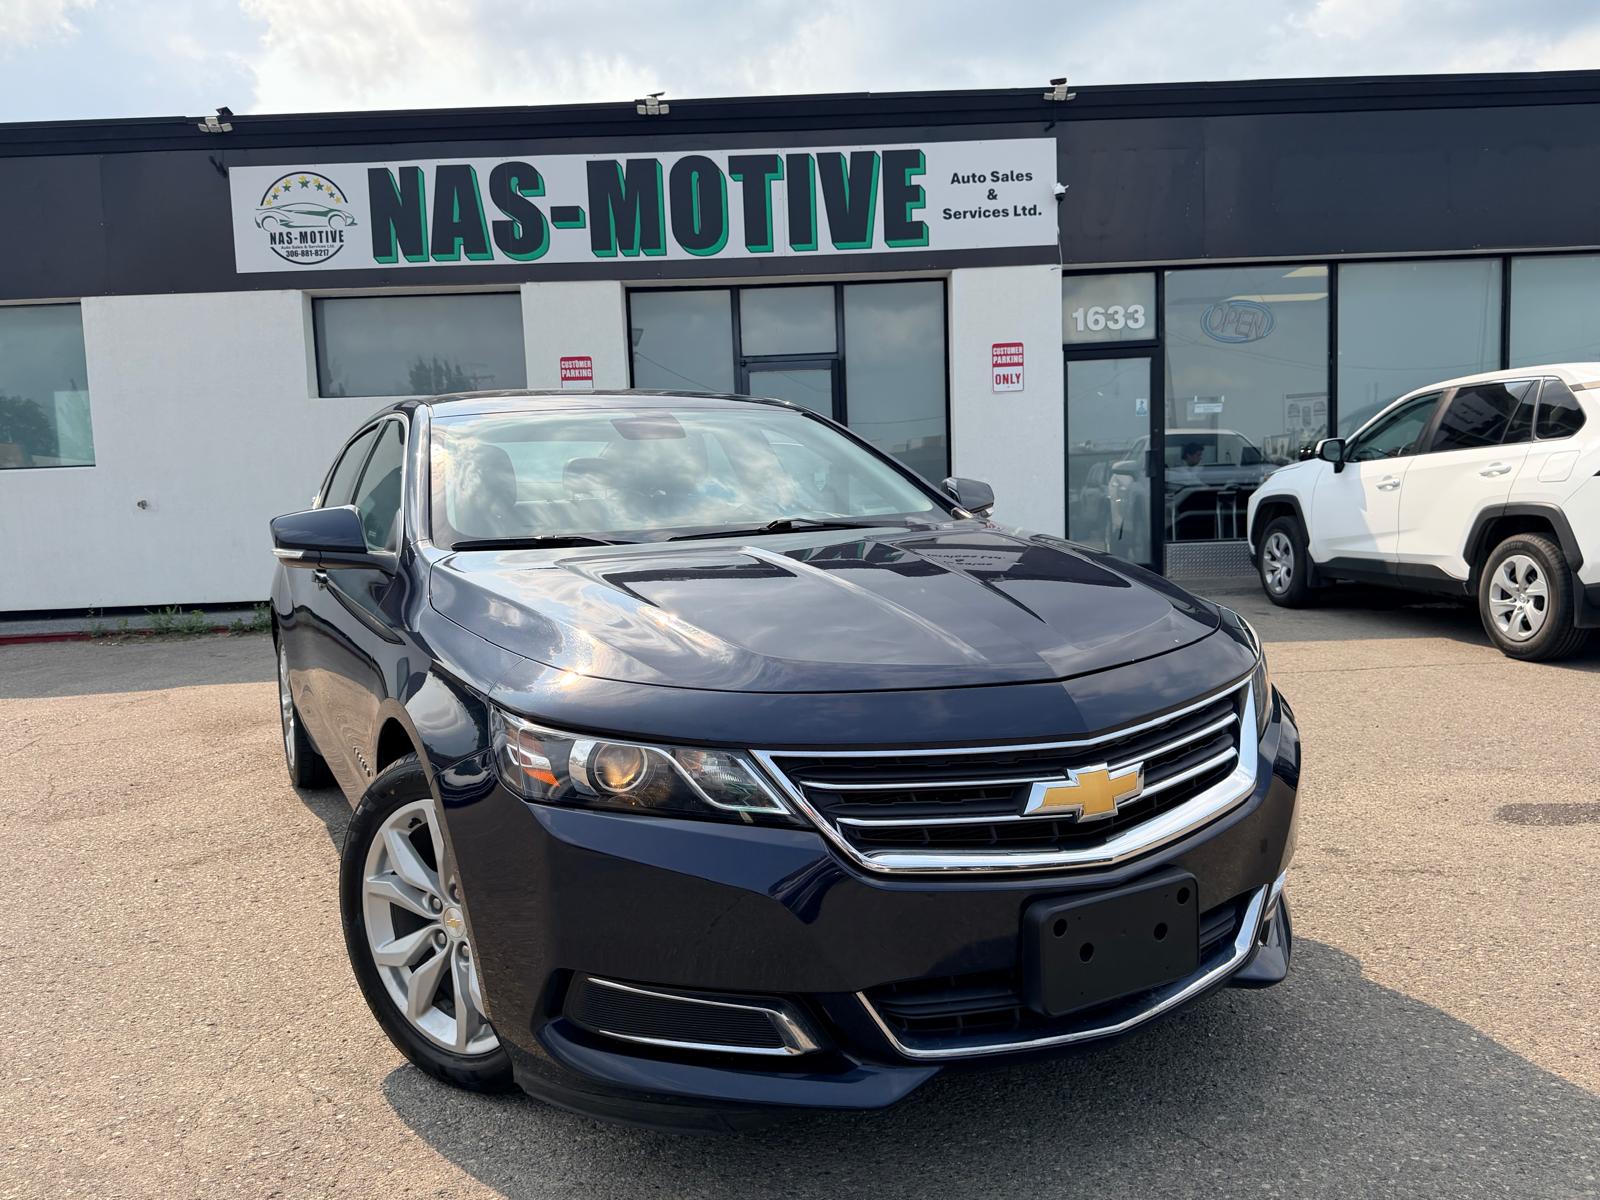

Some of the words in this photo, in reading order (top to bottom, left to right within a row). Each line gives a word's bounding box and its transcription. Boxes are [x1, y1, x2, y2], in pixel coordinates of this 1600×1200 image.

[951, 173, 986, 184] Auto
[990, 170, 1033, 182] Sales
[987, 188, 998, 200] &
[367, 149, 929, 264] NAS-MOTIVE
[942, 206, 1009, 220] Services
[1013, 204, 1042, 217] Ltd.
[270, 230, 344, 245] NAS-MOTIVE
[285, 249, 329, 257] 306-881-8217
[1072, 304, 1145, 332] 1633
[1209, 303, 1266, 338] OPEN
[561, 360, 592, 368] CUSTOMER
[993, 355, 1023, 364] PARKING
[561, 368, 592, 378] PARKING
[995, 372, 1021, 385] ONLY
